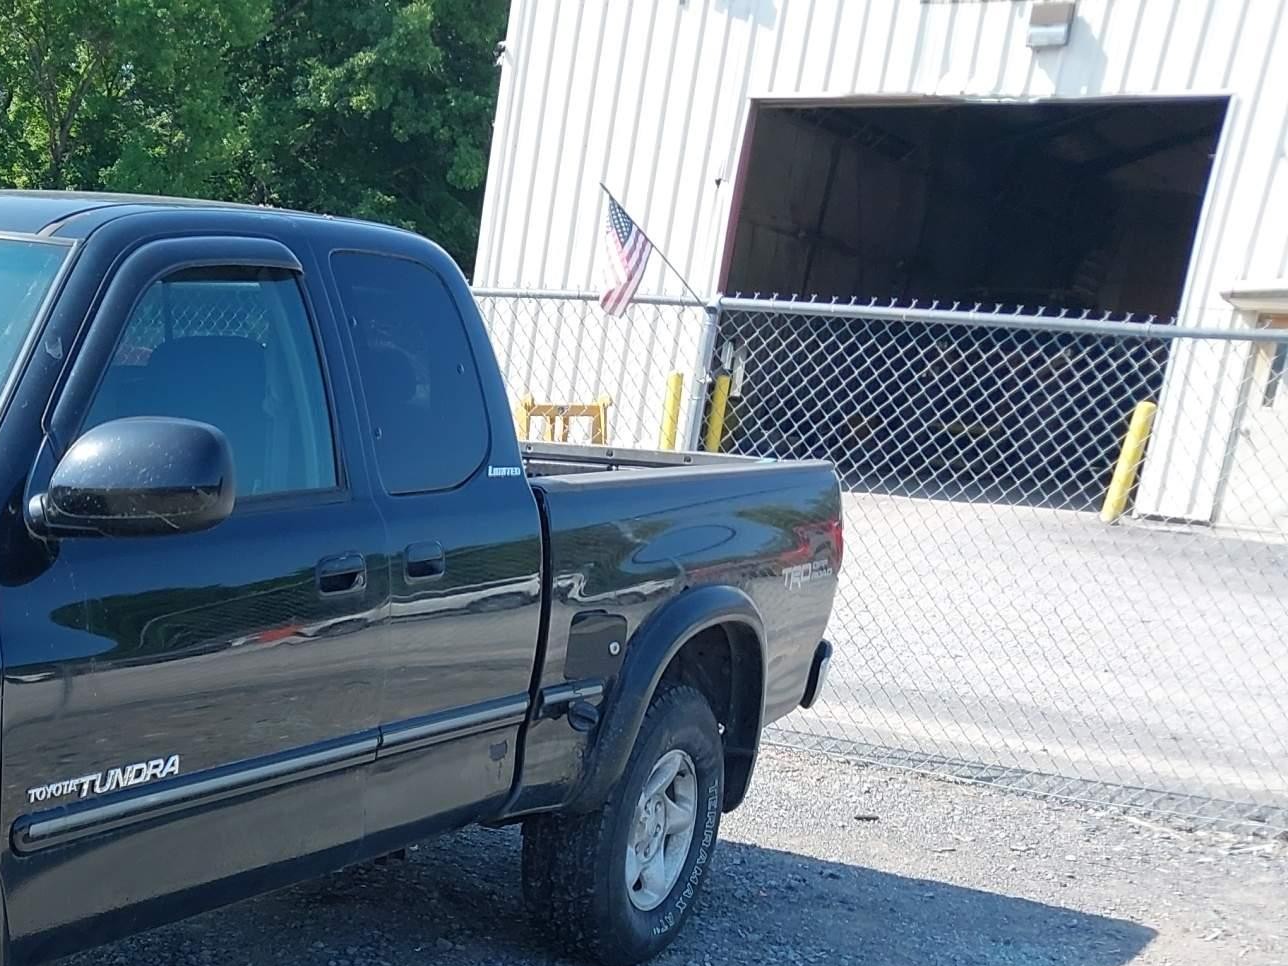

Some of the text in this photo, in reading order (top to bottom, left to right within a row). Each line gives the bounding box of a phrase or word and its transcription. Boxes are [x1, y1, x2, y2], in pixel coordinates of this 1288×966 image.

[781, 562, 812, 592] TRD
[27, 754, 181, 803] TOYOTA TUNDRA
[675, 778, 720, 914] TERRAMAX
